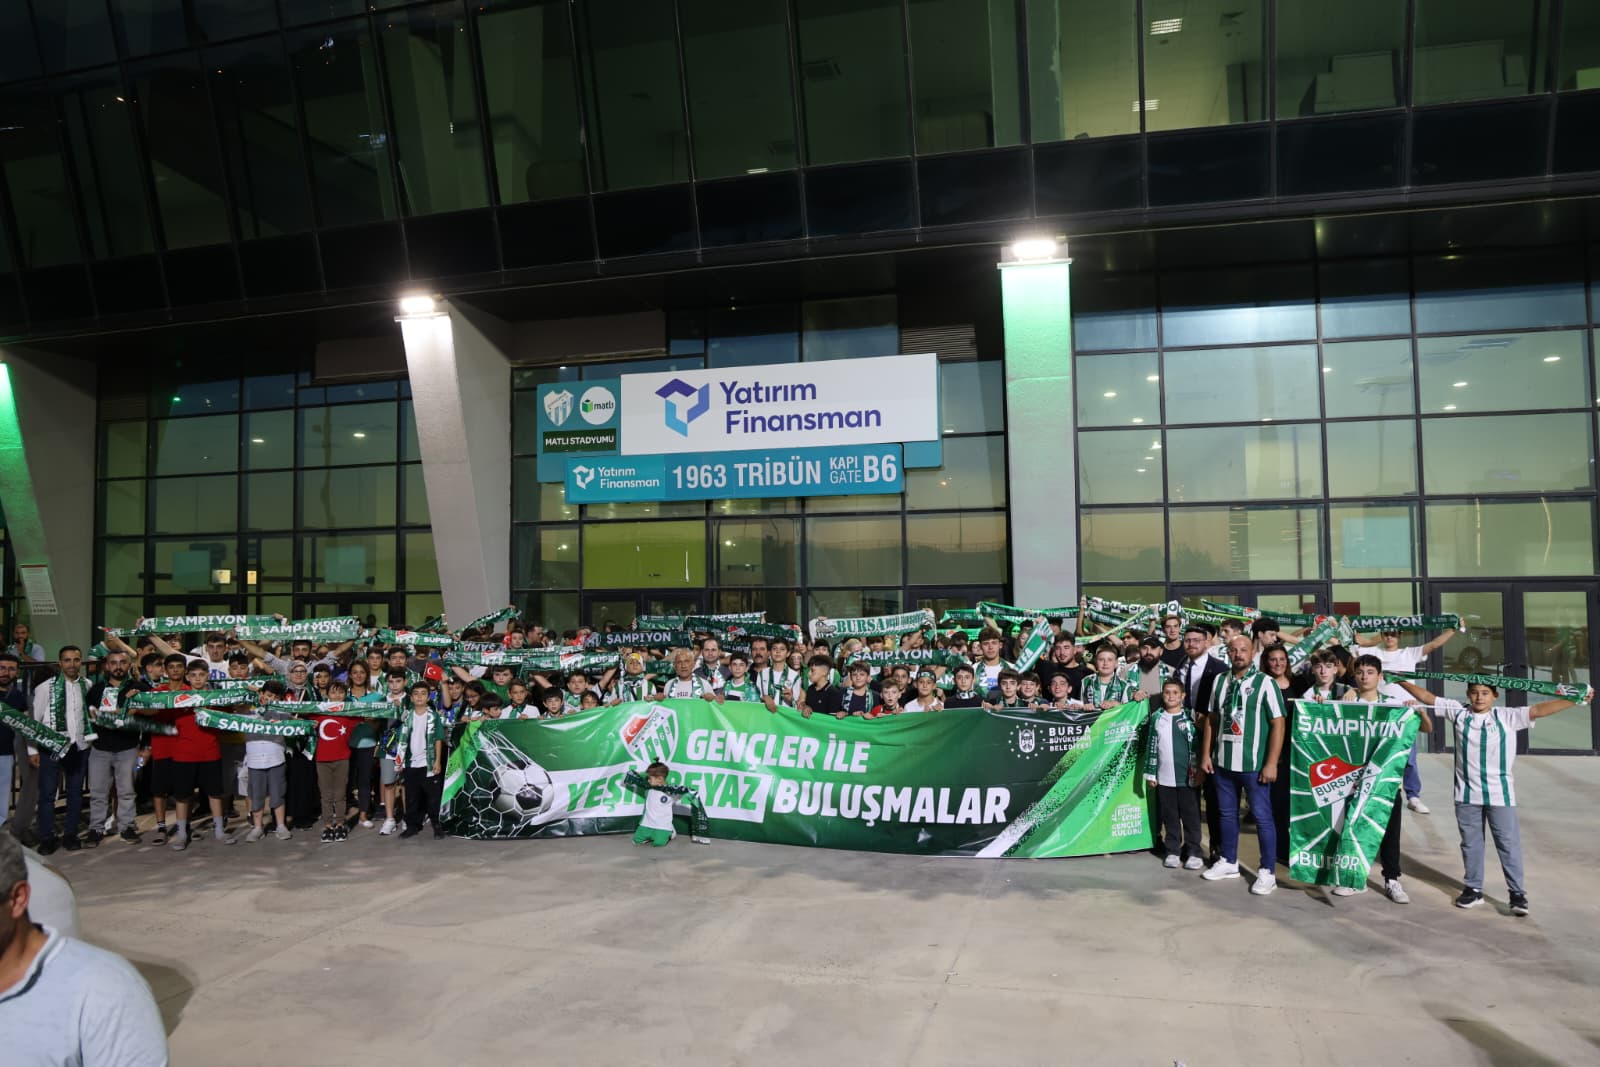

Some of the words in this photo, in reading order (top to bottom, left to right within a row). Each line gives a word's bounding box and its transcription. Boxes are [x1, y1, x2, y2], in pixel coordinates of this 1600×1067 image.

[720, 381, 816, 404] Yatırım
[726, 409, 881, 434] Finansman
[545, 437, 569, 446] MATLI
[570, 435, 615, 445] STADYUMU
[598, 466, 636, 478] Yatırım
[672, 464, 727, 489] 1963
[734, 456, 821, 487] TRİBÜN
[830, 456, 858, 470] KAPI
[863, 454, 897, 483] B6
[600, 478, 660, 489] Finansman
[830, 470, 862, 484] GATE
[836, 618, 887, 633] BURSA
[1049, 725, 1092, 736] BURSA
[686, 729, 820, 770] GENÇLER
[823, 733, 871, 773] İLE
[1315, 767, 1366, 796] BURSASP
[772, 778, 1011, 826] BULUŞMALAR
